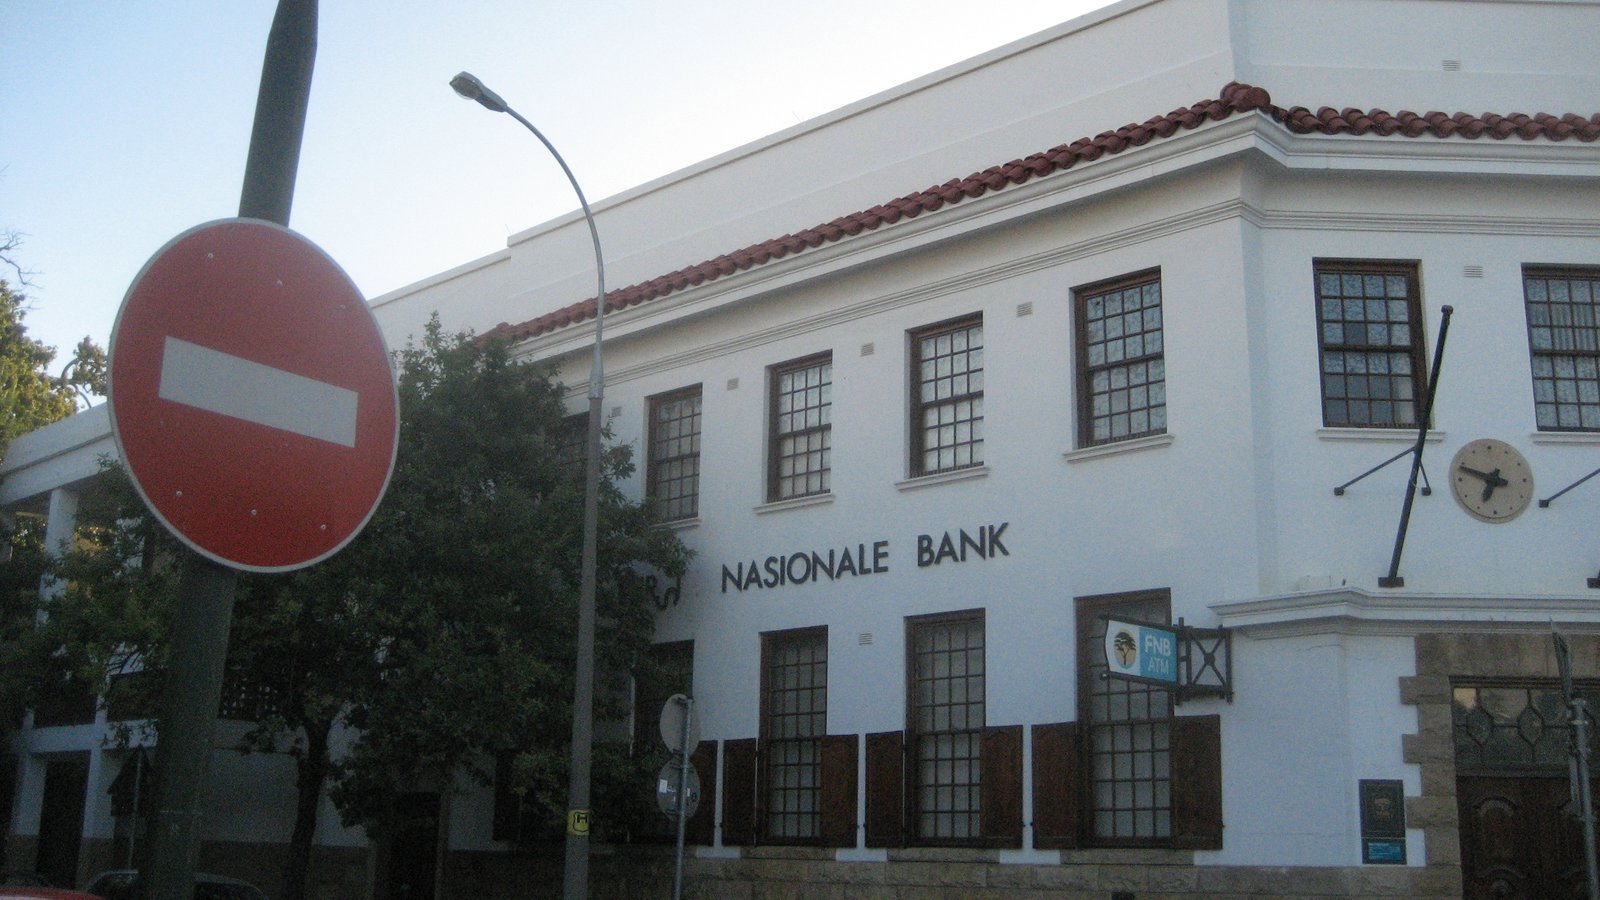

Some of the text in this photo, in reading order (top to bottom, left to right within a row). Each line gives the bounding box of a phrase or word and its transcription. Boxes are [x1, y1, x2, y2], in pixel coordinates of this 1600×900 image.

[722, 522, 1010, 593] NASIONALE BANK
[1144, 635, 1171, 657] FNB
[1147, 657, 1169, 675] ATM
[577, 814, 587, 823] H
